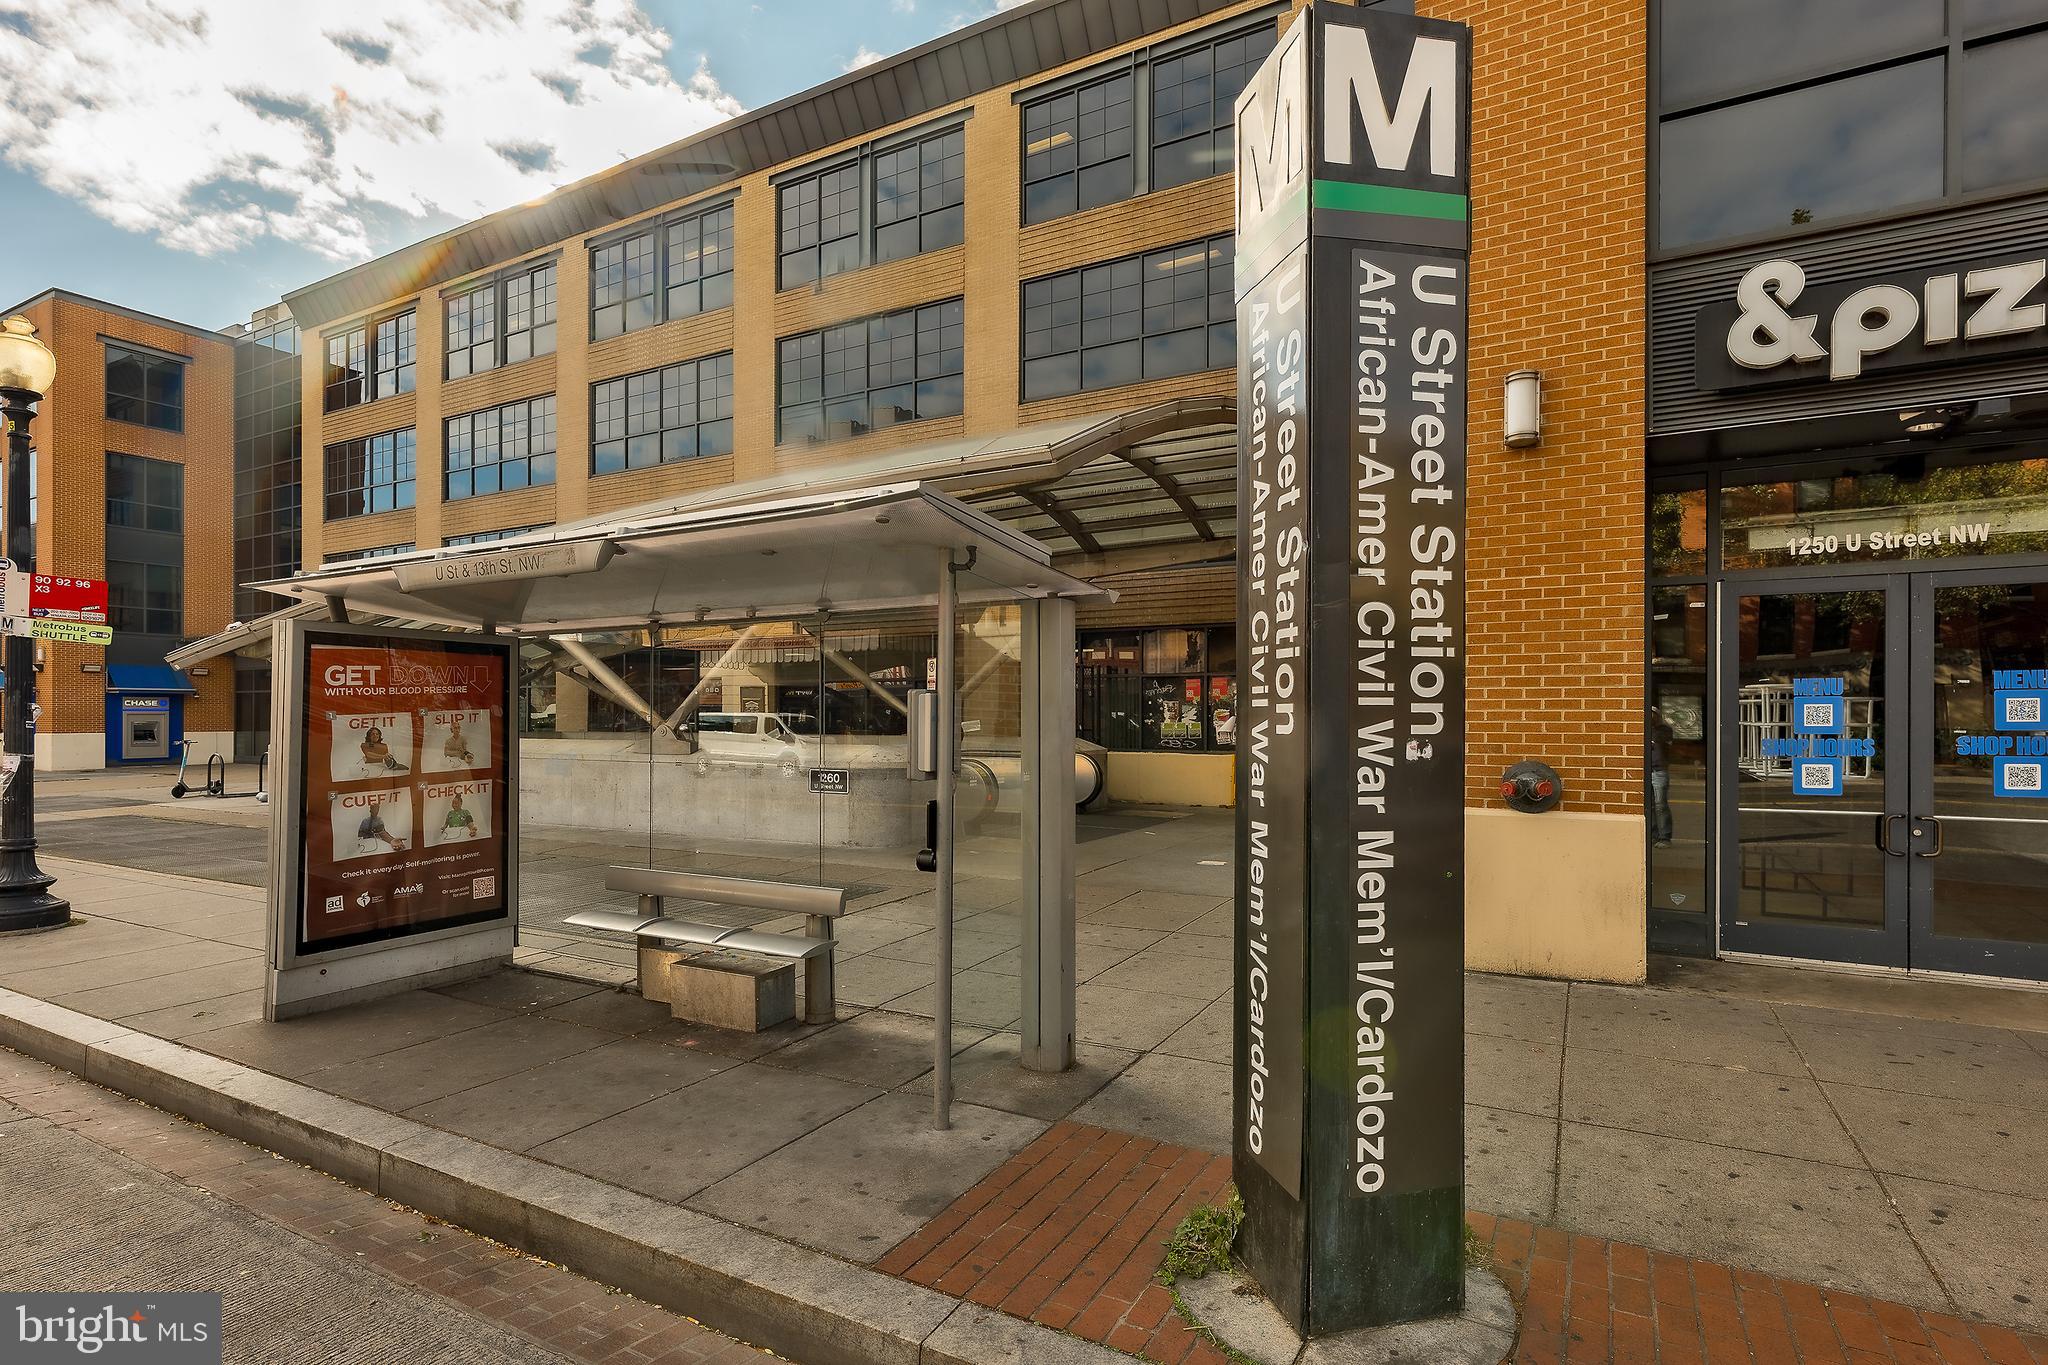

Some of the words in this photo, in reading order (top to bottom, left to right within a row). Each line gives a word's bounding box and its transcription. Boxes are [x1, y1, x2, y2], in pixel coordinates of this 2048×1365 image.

[1324, 23, 1456, 177] M
[1239, 32, 1303, 235] M
[1276, 263, 1301, 315] U
[1411, 265, 1457, 306] U
[1275, 329, 1302, 512] Street
[1356, 258, 1396, 586] African-Amer
[1410, 326, 1457, 505] Street
[1252, 302, 1271, 597] African-Amer
[1785, 535, 1838, 556] 1250
[1845, 533, 1862, 552] U
[1870, 527, 1942, 551] Street
[1949, 522, 1992, 543] NW
[434, 566, 444, 581] U
[446, 564, 459, 579] St
[462, 563, 471, 578] &
[473, 560, 497, 577] 13th
[500, 558, 516, 575] St,
[518, 555, 541, 571] NW
[34, 585, 50, 593] X3
[35, 576, 51, 584] 90
[56, 578, 71, 587] 92
[75, 580, 91, 588] 96
[2, 617, 13, 629] M
[33, 621, 87, 632] Metrobus
[1275, 526, 1302, 736] Station
[1410, 525, 1456, 735] Station
[32, 630, 88, 641] SHUTTLE
[1251, 611, 1270, 707] Civil
[1356, 601, 1396, 706] Civil
[324, 665, 382, 687] GET
[389, 665, 469, 686] DOWN
[1793, 677, 1844, 696] MENU
[1993, 669, 2048, 689] MENU
[324, 687, 354, 696] WITH
[355, 687, 386, 695] YOUR
[389, 686, 422, 695] BLOOD
[423, 685, 468, 694] PRESSURE
[349, 717, 379, 730] GET
[382, 716, 396, 728] IT
[434, 713, 465, 725] SLIP
[468, 712, 479, 723] IT
[1761, 738, 1810, 757] SHOP
[1812, 738, 1876, 757] HOURS
[1956, 736, 2013, 755] SHOP
[2016, 736, 2048, 755] HO
[1250, 720, 1270, 808] War
[1356, 719, 1395, 814] War
[342, 793, 386, 808] CUFF
[389, 791, 400, 804] IT
[427, 784, 474, 799] CHECK
[477, 782, 490, 794] IT
[342, 869, 365, 879] Check
[372, 866, 392, 875] every
[394, 884, 416, 895] AMA
[328, 897, 342, 907] ad
